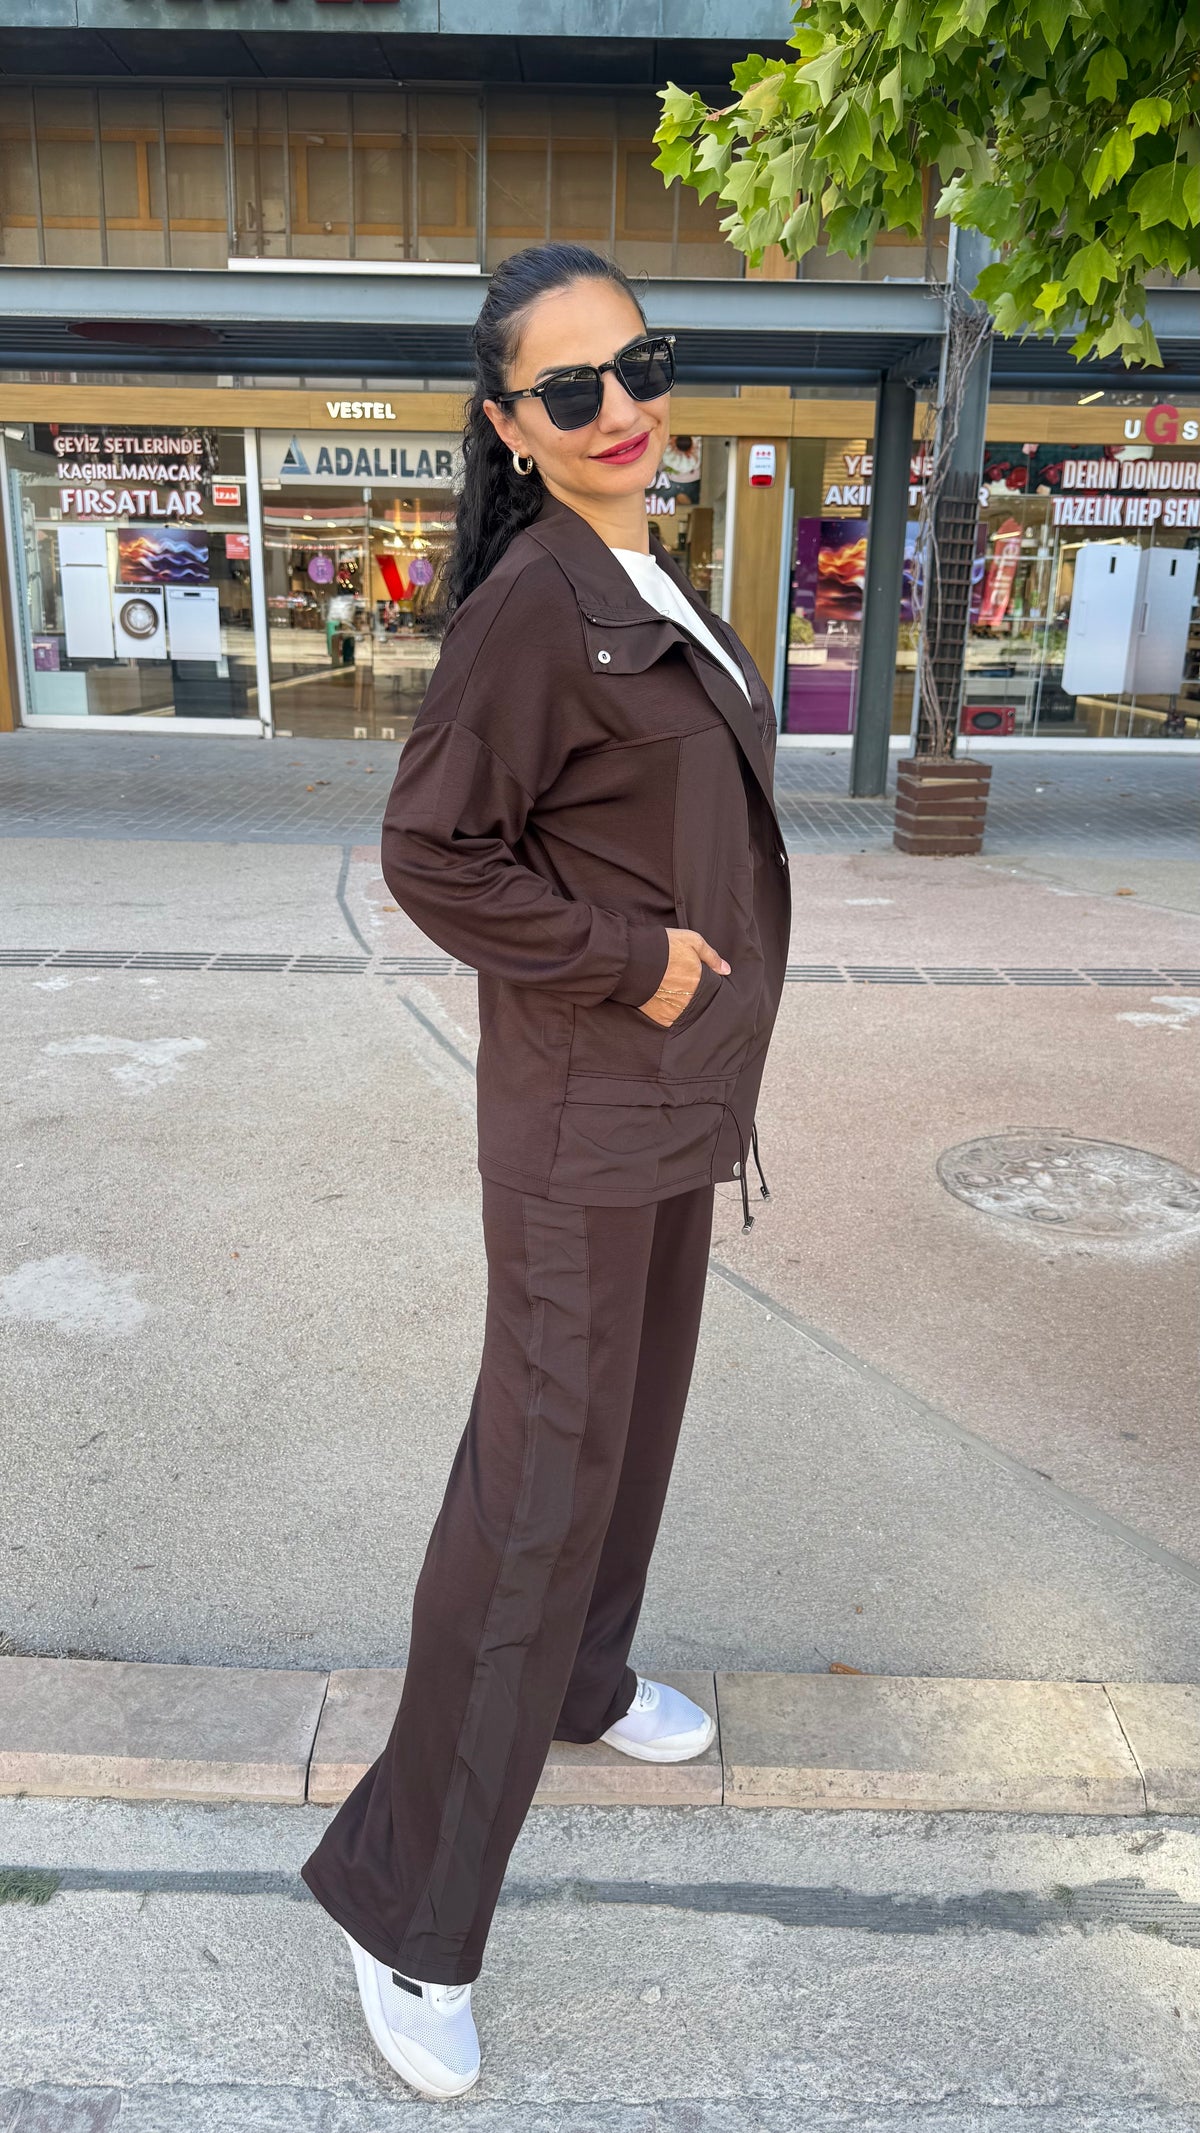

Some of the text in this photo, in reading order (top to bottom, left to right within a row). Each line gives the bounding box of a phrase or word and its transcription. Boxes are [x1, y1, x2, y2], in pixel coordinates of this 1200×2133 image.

[326, 402, 397, 419] VESTEL
[54, 434, 204, 456] ÇEYİZ SETLERİNDE
[57, 462, 203, 484] KAÇIRILMAYACAK
[315, 446, 453, 480] ADALILAR
[1062, 457, 1119, 490] DERİN
[60, 488, 204, 516] FIRSATLAR
[1052, 495, 1200, 527] TAZELİK HEP SEN
